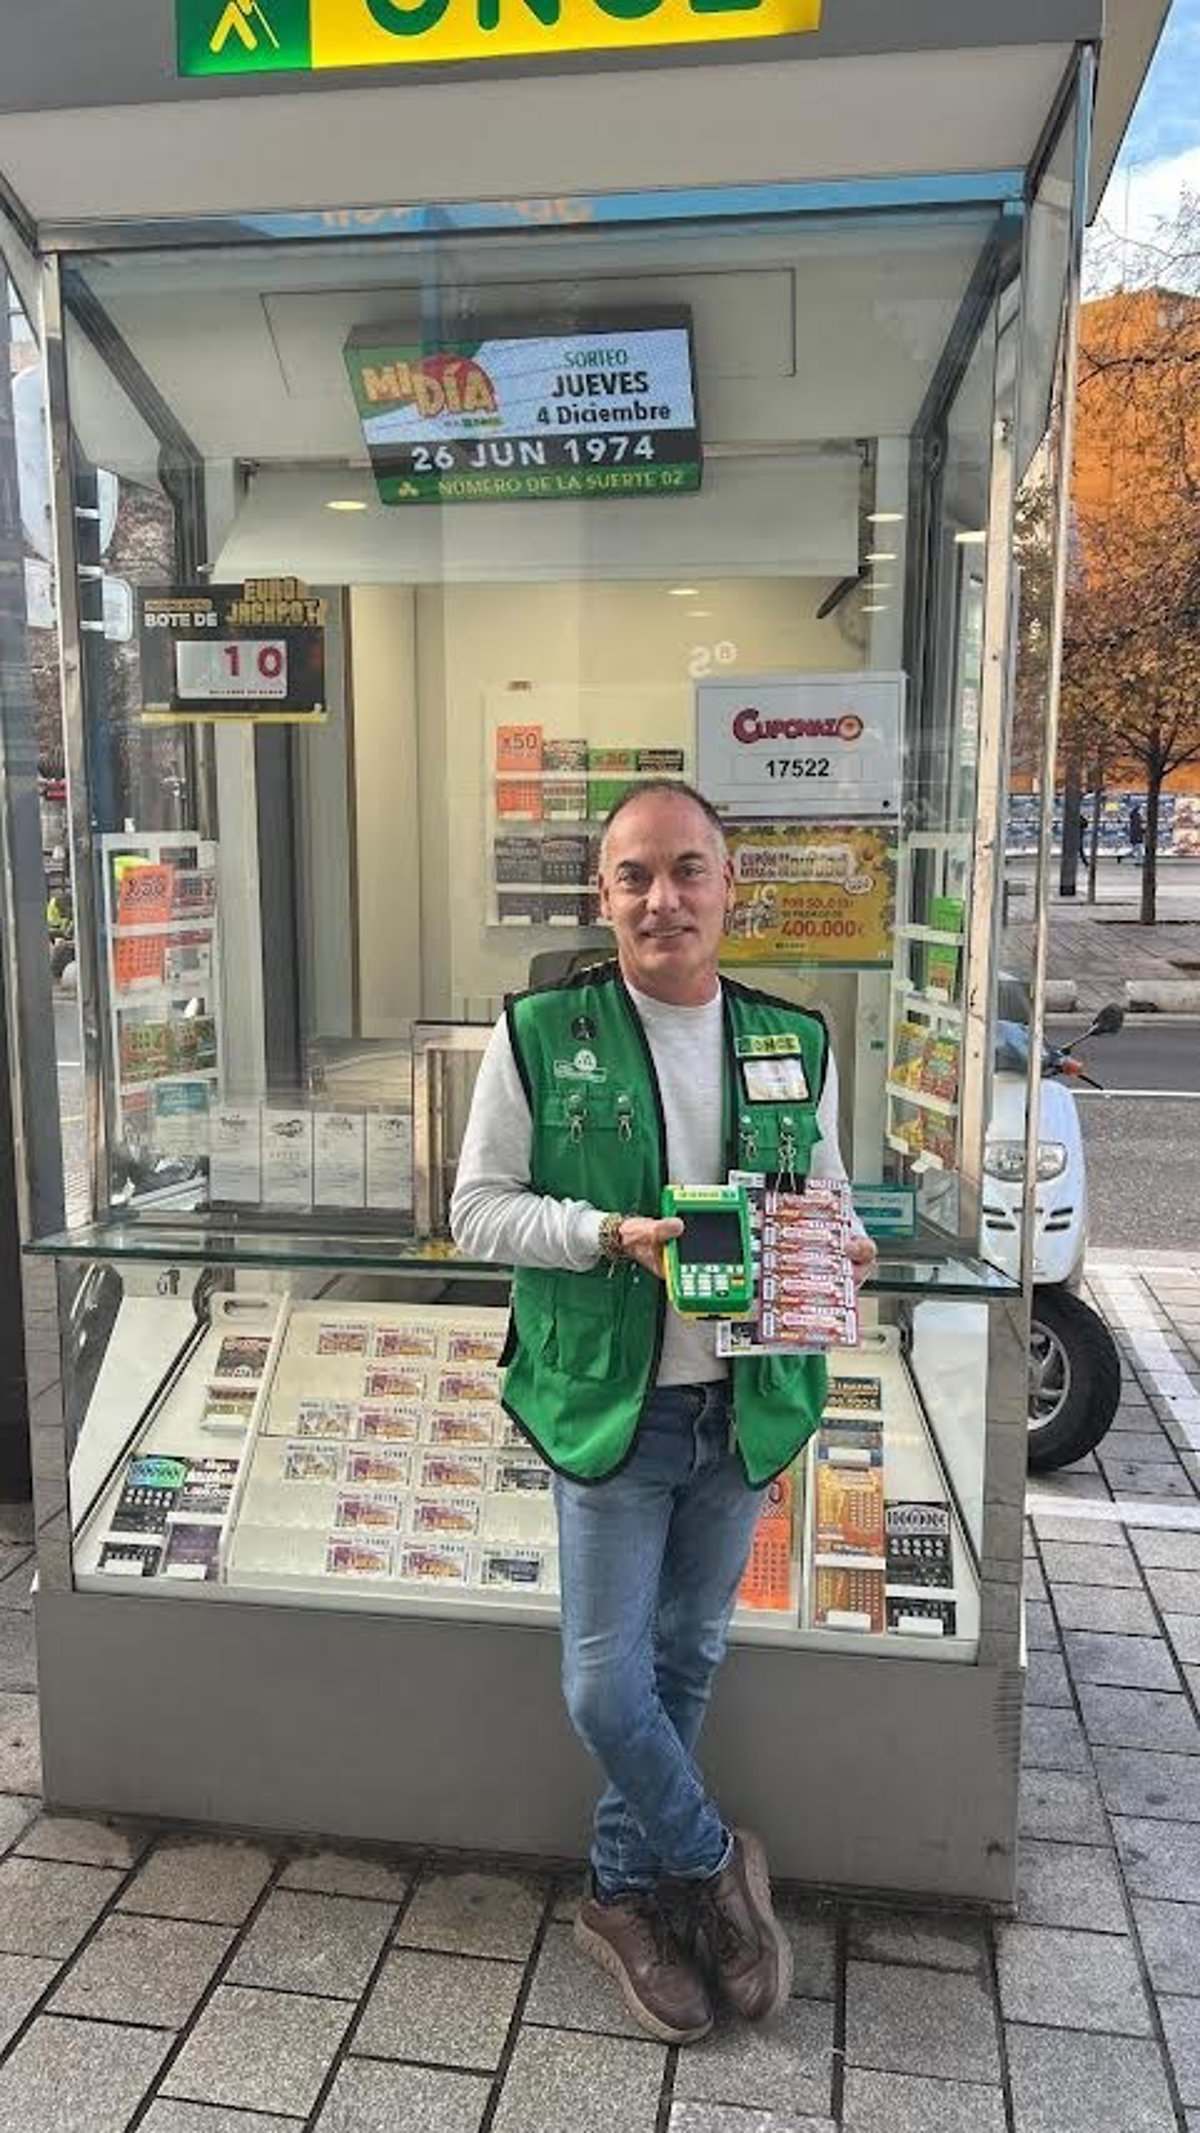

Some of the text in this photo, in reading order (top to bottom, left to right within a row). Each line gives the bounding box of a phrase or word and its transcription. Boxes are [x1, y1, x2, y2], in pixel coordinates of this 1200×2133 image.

[565, 349, 629, 368] SORTEO
[552, 371, 650, 397] JUEVES
[536, 400, 671, 426] 4 Diciembre
[411, 435, 655, 471] 26 JUN 1974
[528, 477, 551, 494] DE
[556, 474, 583, 492] LA
[586, 472, 656, 491] SUERTE
[661, 469, 685, 487] 02
[144, 612, 218, 628] BOTE DE
[765, 758, 830, 778] 17522
